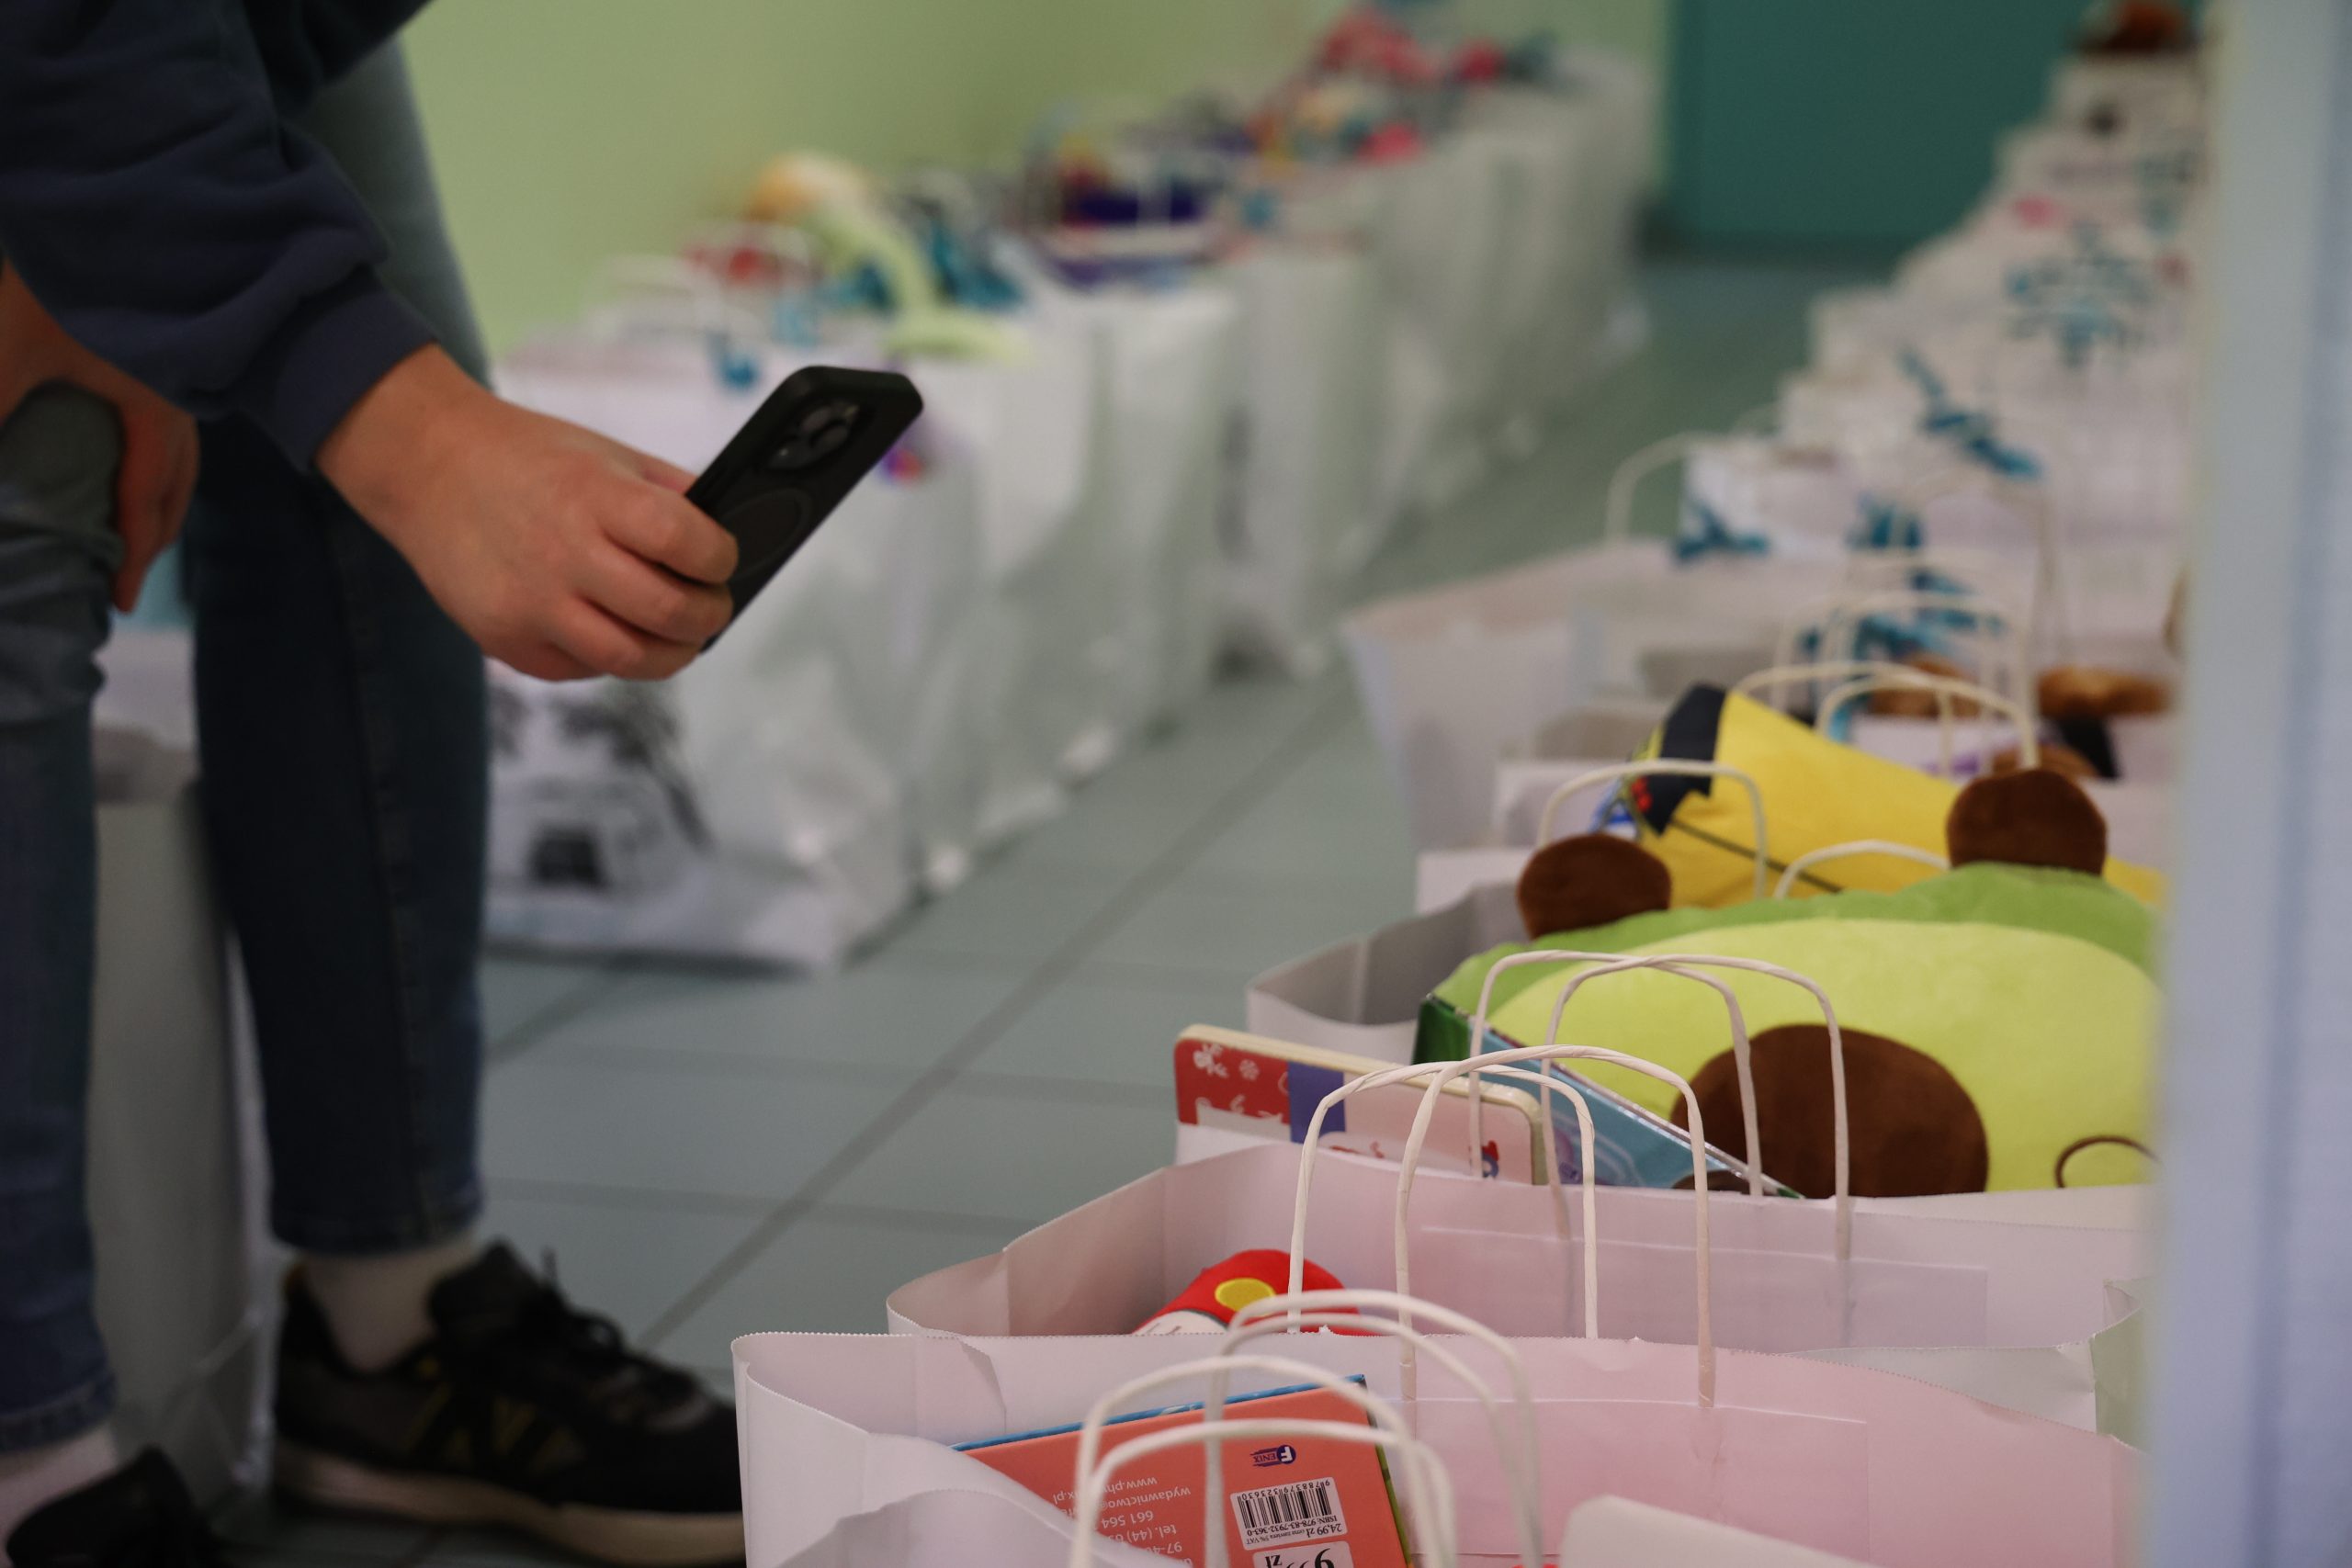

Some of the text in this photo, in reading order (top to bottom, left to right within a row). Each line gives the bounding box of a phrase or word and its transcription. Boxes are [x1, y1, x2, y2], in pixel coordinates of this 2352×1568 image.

[1101, 1510, 1153, 1529] 661 564
[1247, 1515, 1337, 1536] ISBN: 978-83-7932-363-0
[1126, 1528, 1152, 1543] (44)
[1155, 1524, 1176, 1538] tel.
[1306, 1529, 1315, 1538] zł
[1317, 1523, 1342, 1535] 24,99
[1246, 1537, 1259, 1545] VAT
